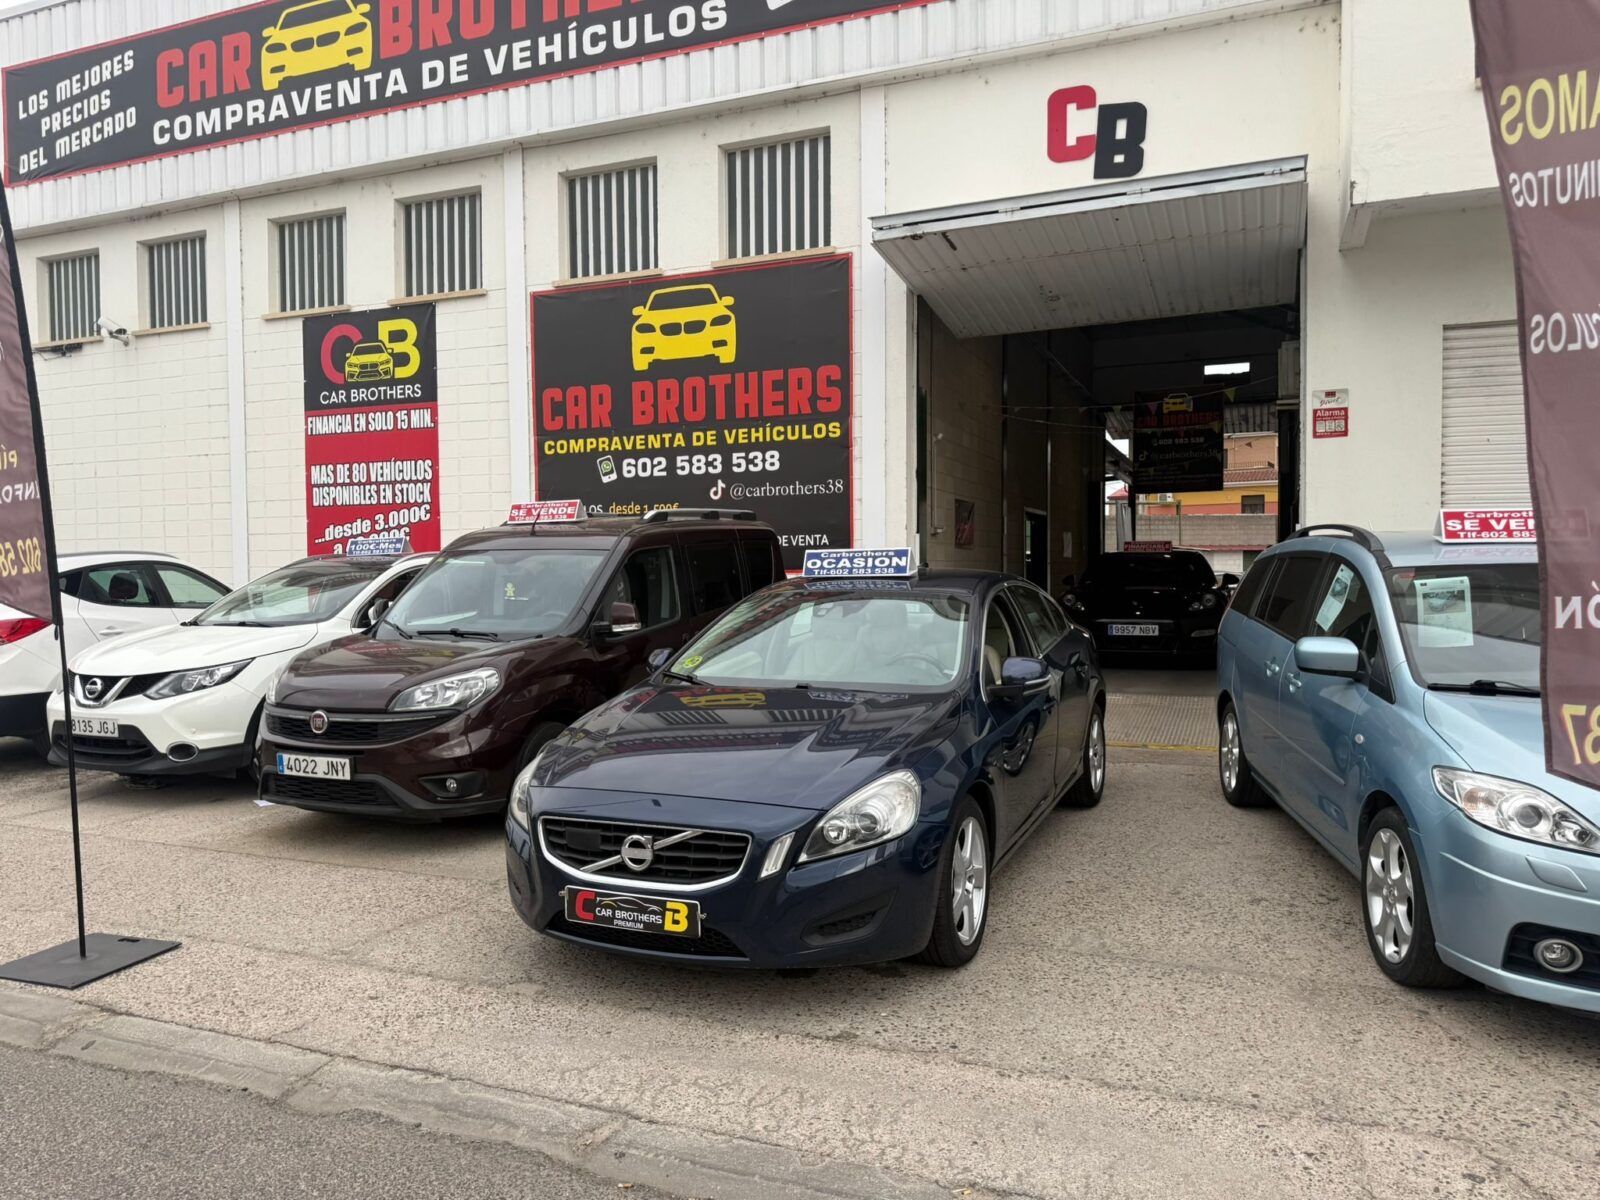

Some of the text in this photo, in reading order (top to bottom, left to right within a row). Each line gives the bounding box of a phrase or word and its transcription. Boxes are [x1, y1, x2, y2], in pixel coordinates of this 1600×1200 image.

[153, 68, 408, 145] COMPRAVENTA
[423, 53, 469, 90] DE
[484, 0, 728, 76] VEHÍCULOS
[156, 31, 251, 109] CAR
[19, 50, 134, 120] LOS MEJORES
[41, 89, 111, 138] PRECIOS
[19, 107, 137, 175] DEL MERCADO
[320, 384, 422, 404] CAR BROTHERS
[542, 364, 842, 431] CAR BROTHERS
[307, 408, 434, 435] FINANCIA EN SOLO 15 MIN.
[544, 422, 841, 455] COMPRAVENTA DE VEHÍCULOS
[311, 457, 433, 485] MAS DE 80 VEHÍCULOS
[622, 450, 780, 479] 602 583 538
[312, 482, 431, 506] DISPONIBLES EN STOCK
[730, 479, 844, 498] @carbrothers38
[531, 507, 575, 516] VENDE
[609, 501, 641, 514] desde
[315, 518, 372, 543] ...desde
[374, 504, 431, 530] 3.000€
[1446, 519, 1480, 531] SE
[790, 534, 829, 546] VENTA
[807, 556, 907, 569] OCASION
[72, 719, 116, 735] 8135 JGJ
[286, 757, 347, 777] 4022 JNY
[595, 907, 663, 924] CAR BROTHERS
[613, 919, 644, 930] PREMIUM
